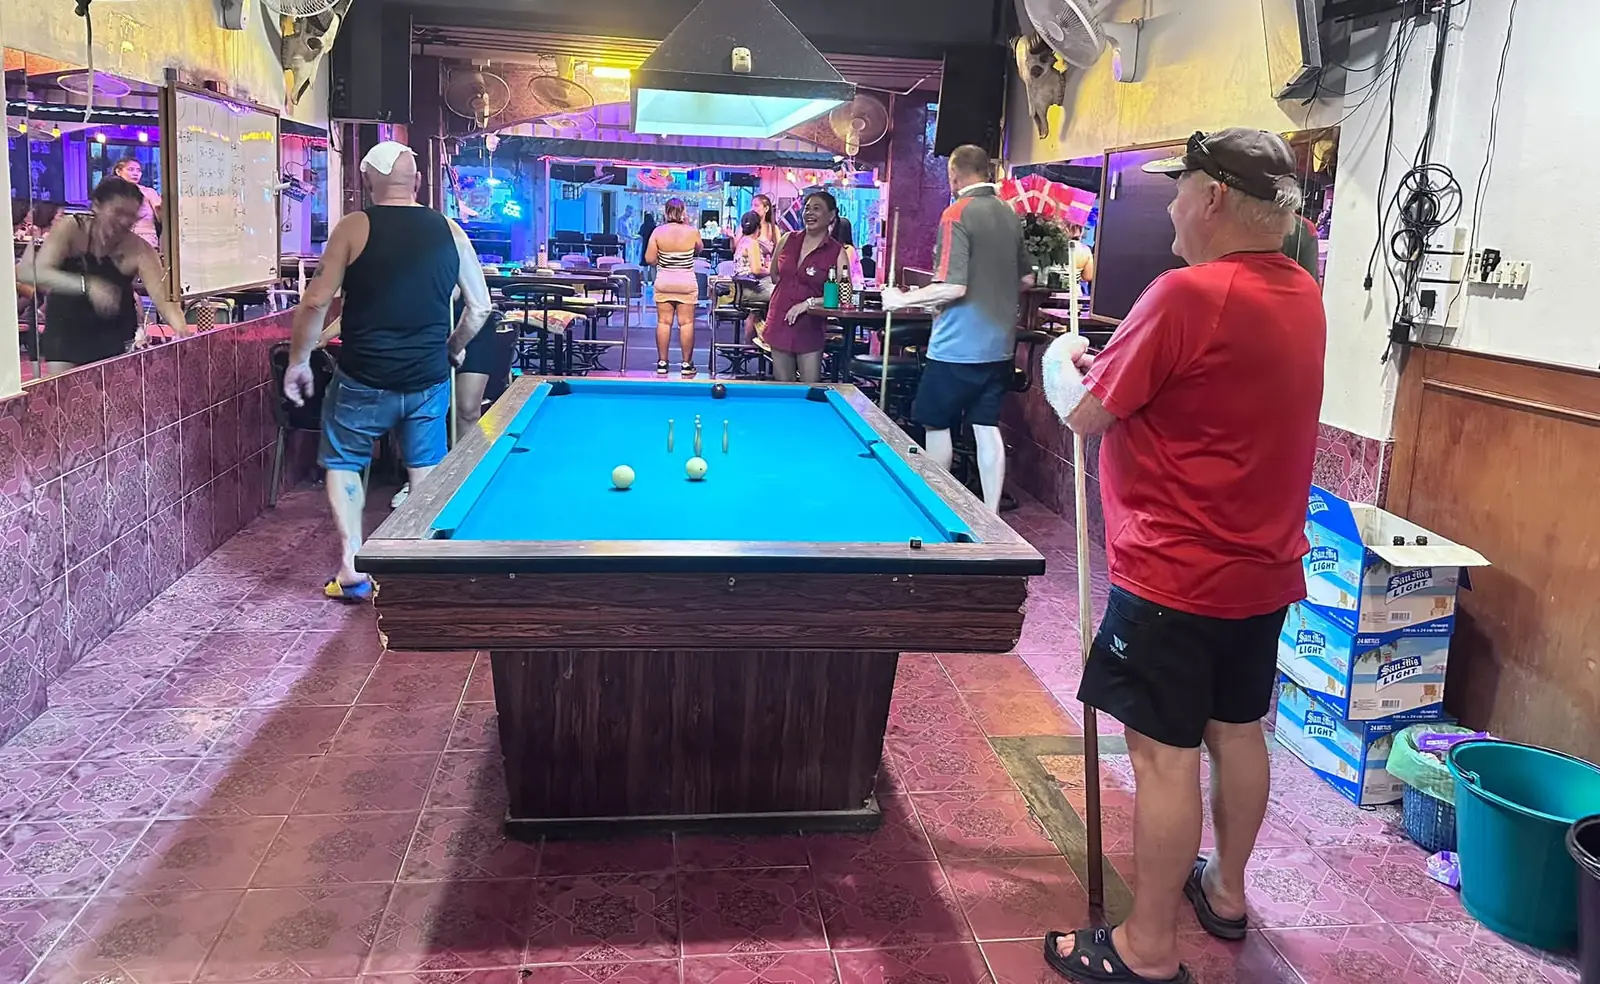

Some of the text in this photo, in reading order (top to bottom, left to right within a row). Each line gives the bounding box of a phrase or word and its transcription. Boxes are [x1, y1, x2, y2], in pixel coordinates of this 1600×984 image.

[1312, 547, 1337, 561] San Mig
[1313, 561, 1336, 572] LIGHT
[1390, 568, 1430, 589] San Mig
[1393, 579, 1429, 598] LIGHT
[1298, 631, 1325, 647] San Mig
[1299, 645, 1323, 655] LIGHT
[1380, 657, 1419, 677] San Mig
[1383, 667, 1418, 685] LIGHT
[1307, 711, 1335, 729] San Mig
[1308, 726, 1334, 737] LIGHT
